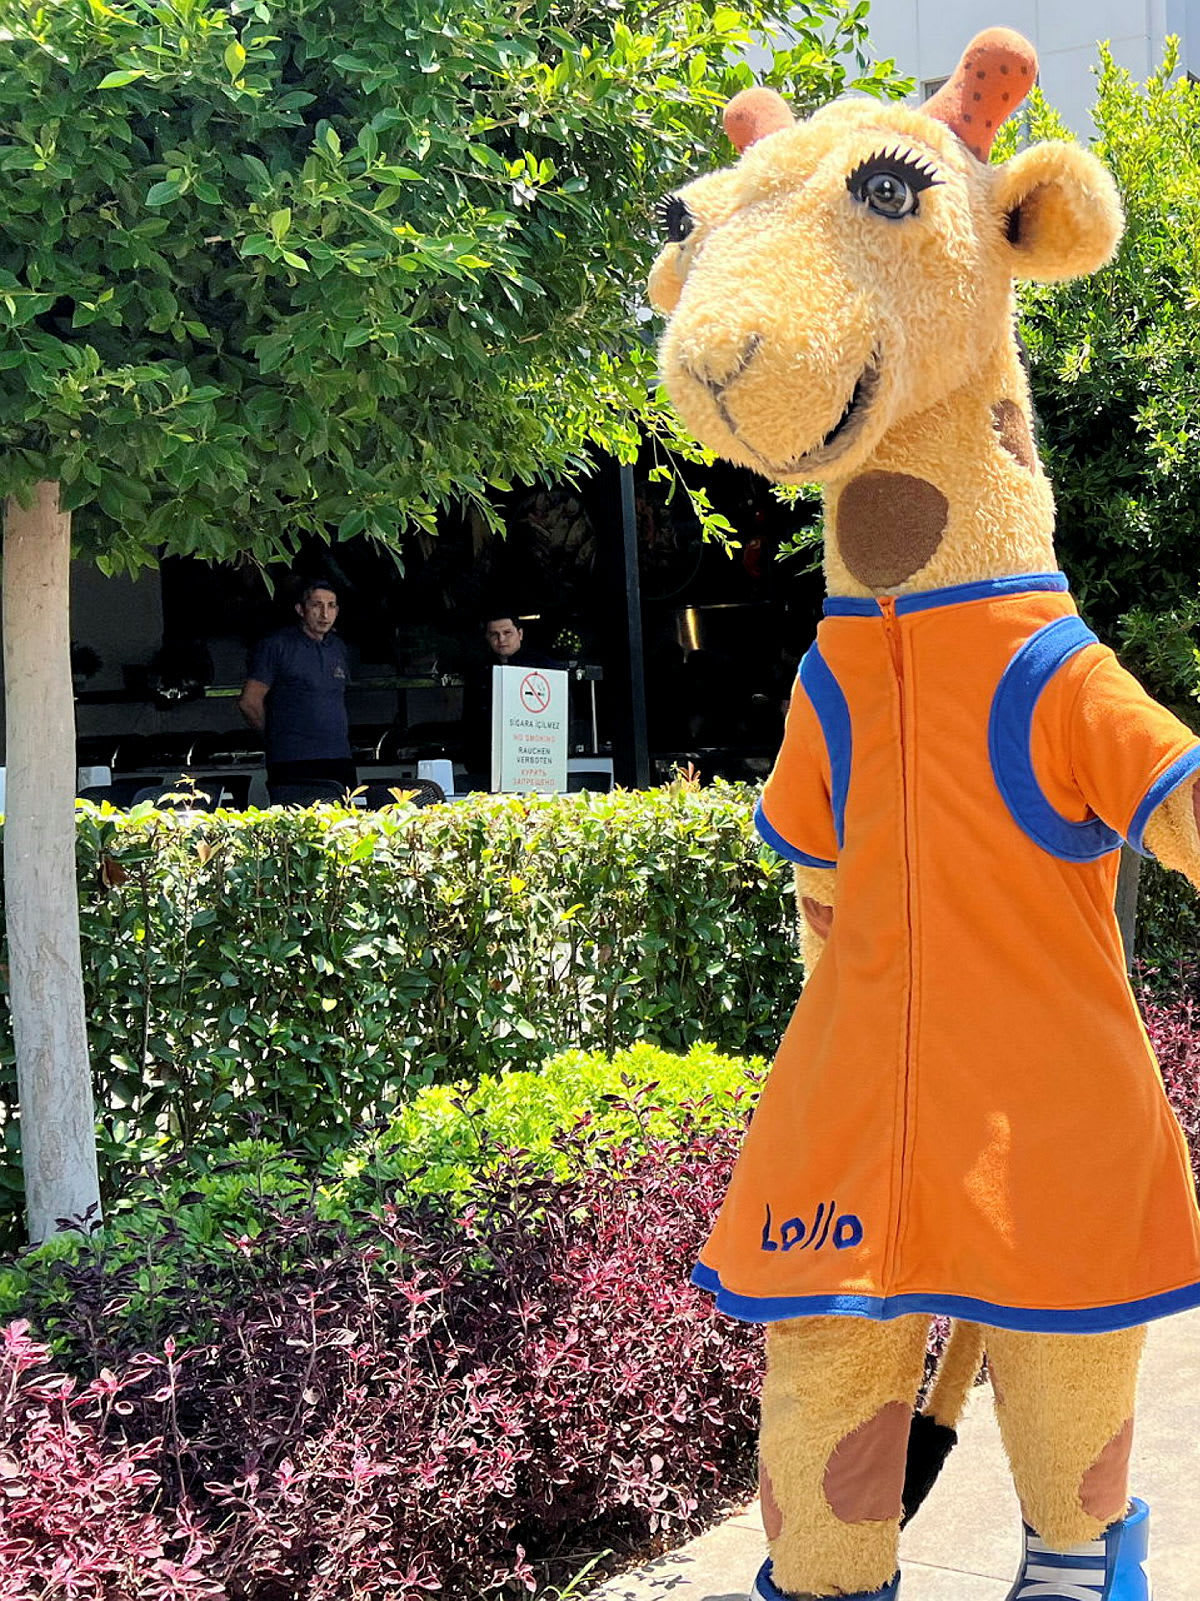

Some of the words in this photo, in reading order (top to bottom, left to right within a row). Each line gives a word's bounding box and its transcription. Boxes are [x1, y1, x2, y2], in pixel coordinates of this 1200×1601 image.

[518, 746, 551, 755] RAUCHEN
[516, 756, 552, 765] VERBOTEN
[760, 1200, 864, 1251] Lollo
